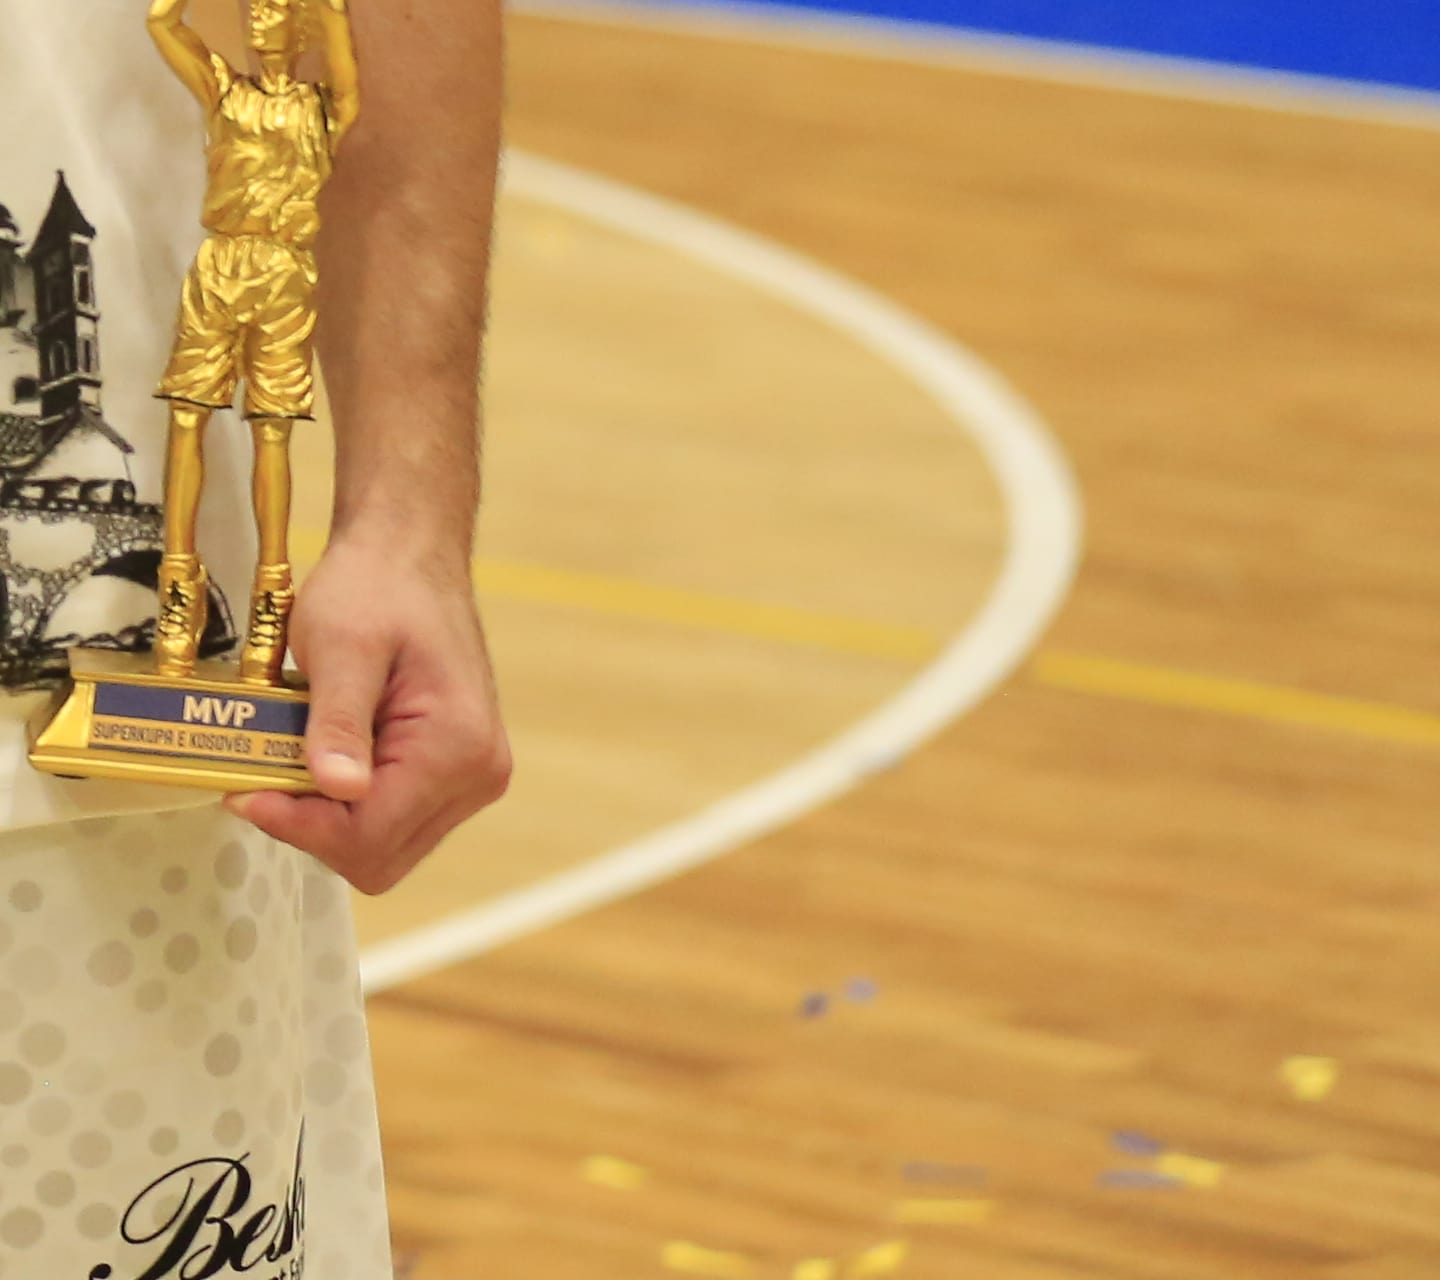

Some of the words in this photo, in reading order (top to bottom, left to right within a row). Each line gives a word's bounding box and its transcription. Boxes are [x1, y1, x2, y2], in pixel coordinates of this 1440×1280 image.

[182, 695, 257, 728] MVP
[94, 721, 174, 745] SUPERKUPA
[178, 730, 185, 748] E
[263, 739, 304, 760] 2020-
